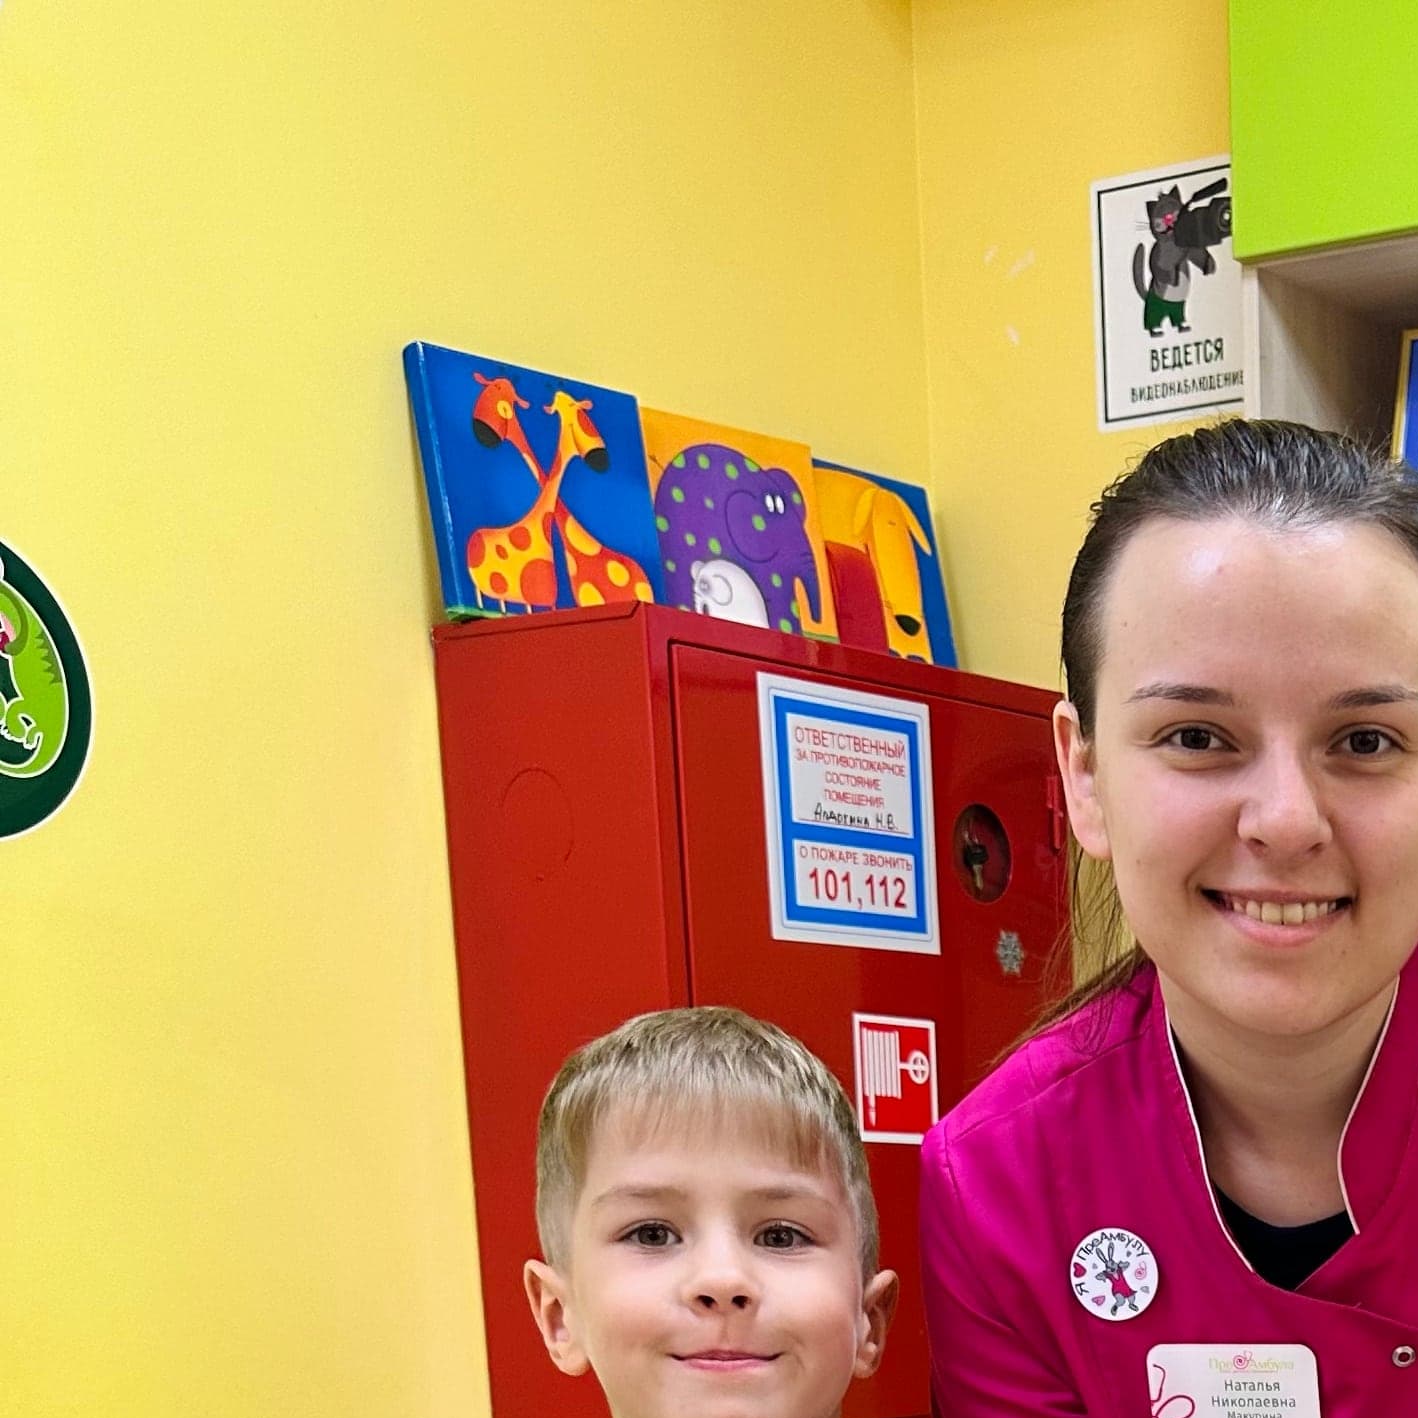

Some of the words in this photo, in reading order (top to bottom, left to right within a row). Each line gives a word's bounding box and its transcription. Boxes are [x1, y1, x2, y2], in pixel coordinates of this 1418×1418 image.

[1150, 338, 1224, 372] ВЕДЕТСЯ
[1131, 369, 1244, 403] ВИДЕОНАБЛЮДЕНИЕ
[795, 726, 906, 759] ОТВЕТСТВЕННЫЙ
[795, 750, 809, 762] ЗА
[810, 751, 906, 777] ПРОТИВОПОЖАРНОЕ
[824, 771, 882, 791] СОСТОЯНИЕ
[824, 788, 885, 809] ПОМЕЩЕНИЯ
[799, 845, 809, 858] О
[811, 847, 858, 866] ПОЖАРЕ
[863, 854, 913, 871] ЗВОНИТЬ
[809, 867, 907, 910] 101,112
[1074, 1282, 1090, 1297] Я
[1224, 1380, 1281, 1392] Наталья
[1211, 1395, 1296, 1408] Николаевна
